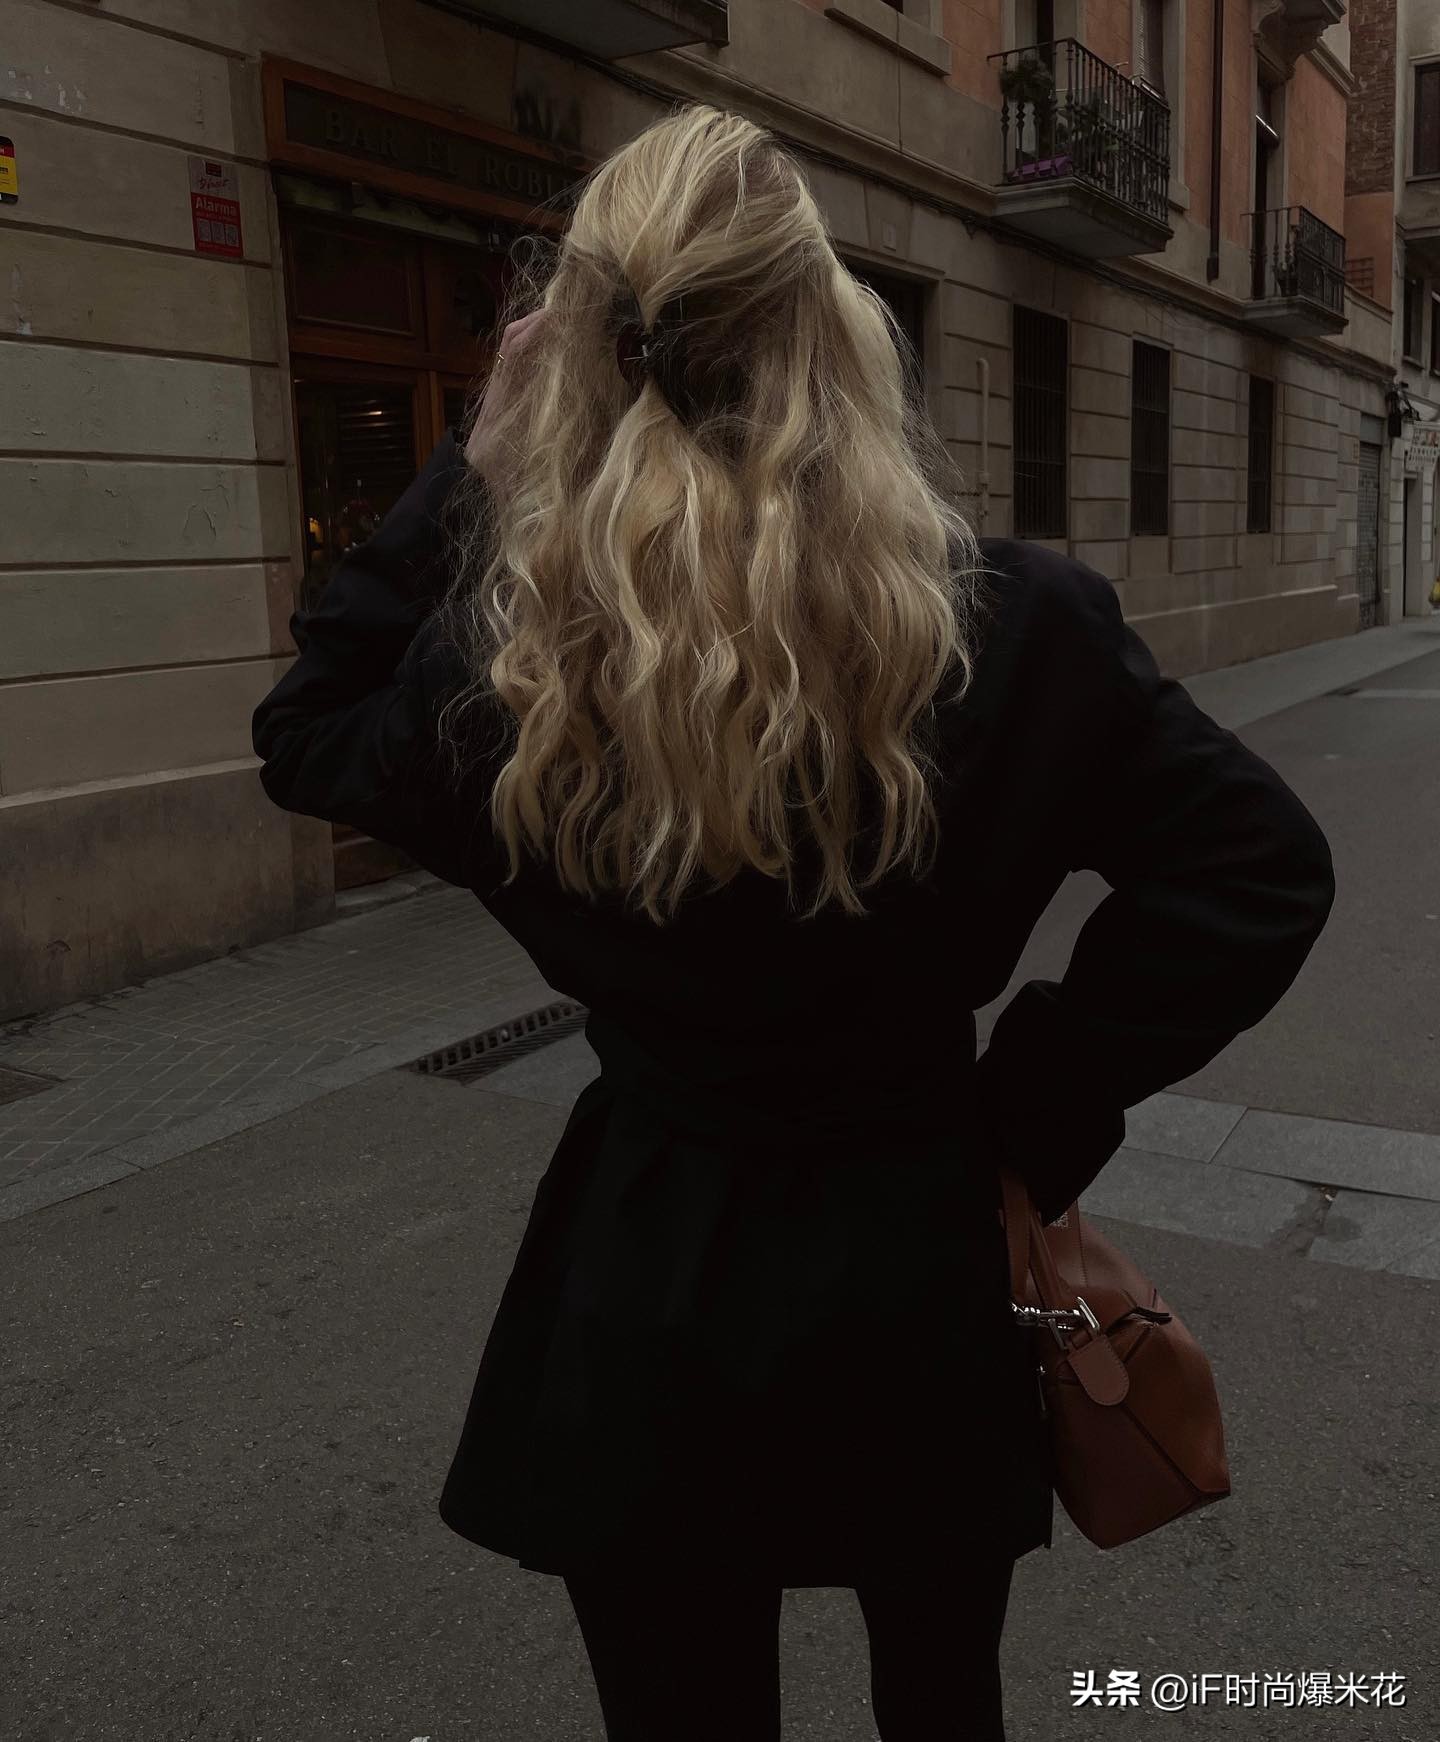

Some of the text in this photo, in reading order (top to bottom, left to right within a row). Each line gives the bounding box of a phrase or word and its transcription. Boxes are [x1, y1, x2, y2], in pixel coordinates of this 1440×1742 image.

[326, 110, 399, 160] BAR
[424, 136, 458, 176] EL
[196, 197, 238, 216] Alarma
